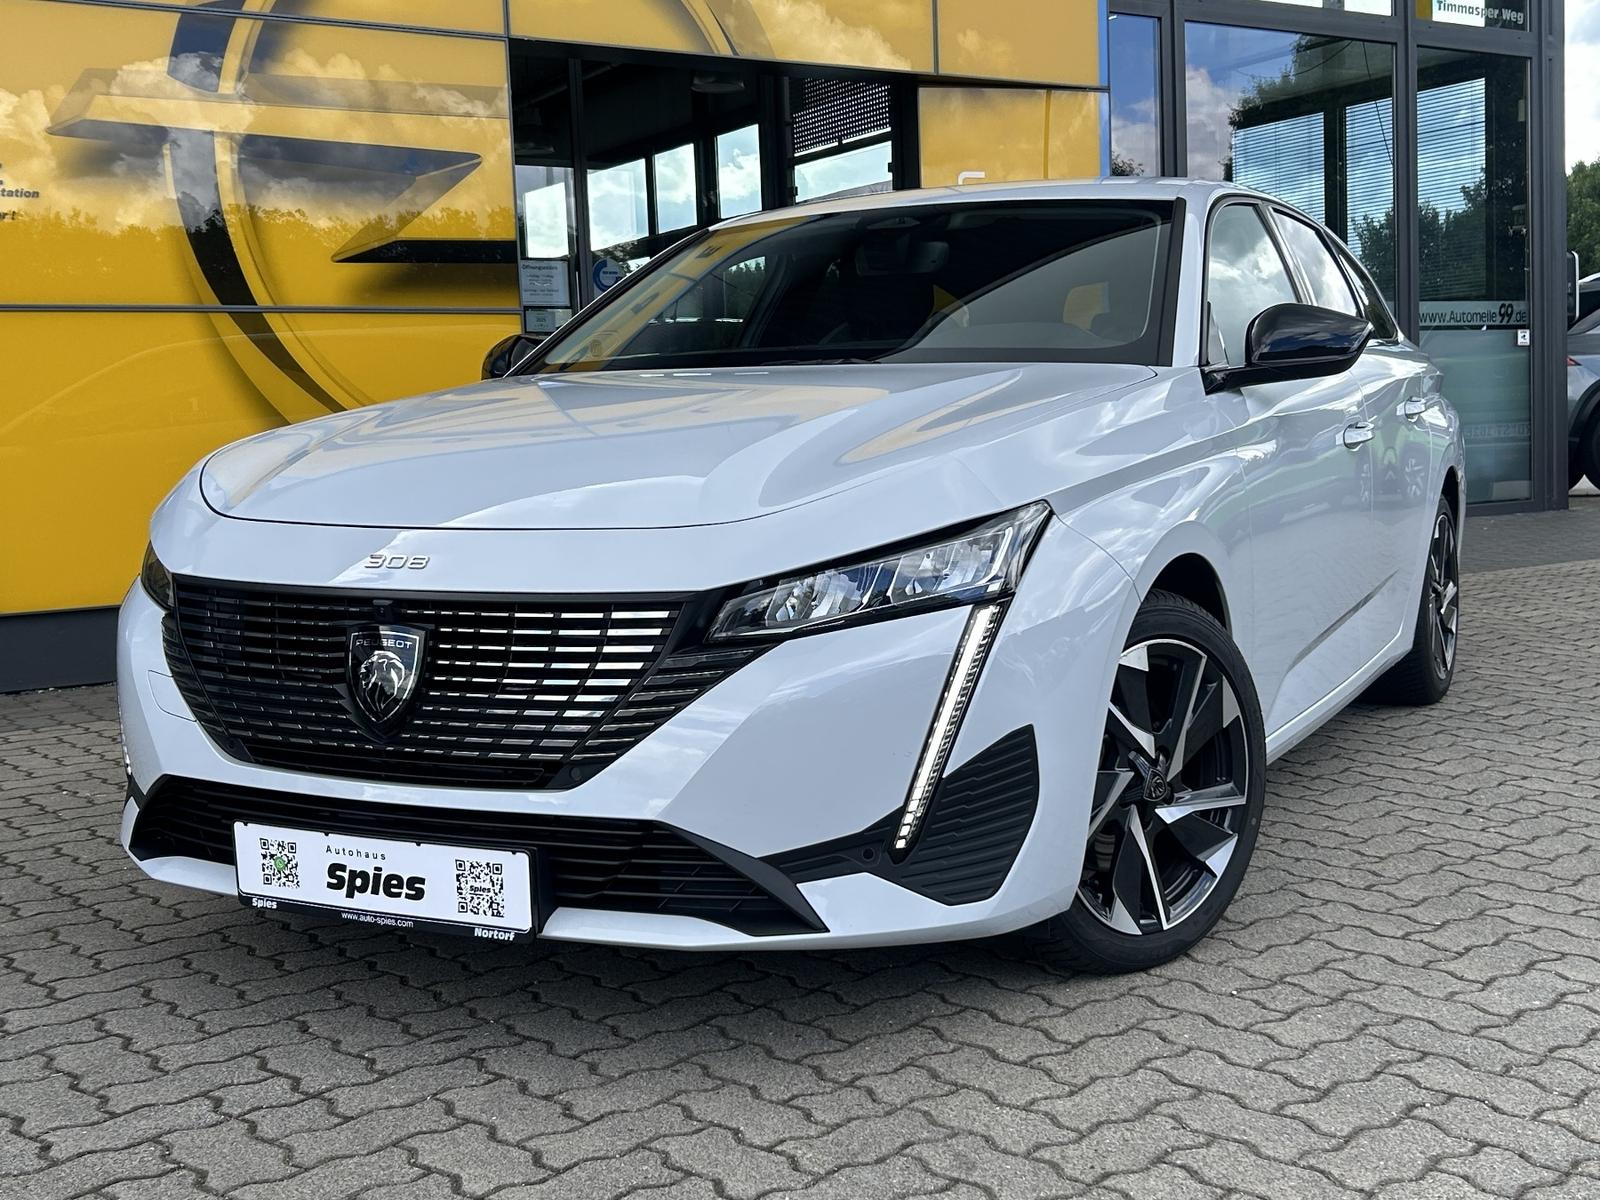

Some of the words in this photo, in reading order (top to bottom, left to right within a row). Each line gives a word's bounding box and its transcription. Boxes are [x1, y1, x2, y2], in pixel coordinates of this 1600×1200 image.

[1436, 0, 1499, 19] Timmasper
[1501, 8, 1525, 25] Weg
[364, 553, 431, 570] 308
[355, 638, 413, 650] PEUGEOT
[325, 844, 387, 861] Autohaus
[326, 862, 426, 901] Spies
[469, 884, 492, 894] Spies
[251, 897, 278, 910] Spies
[341, 911, 414, 929] www.auto-spies.com
[473, 927, 516, 942] Nortorf
